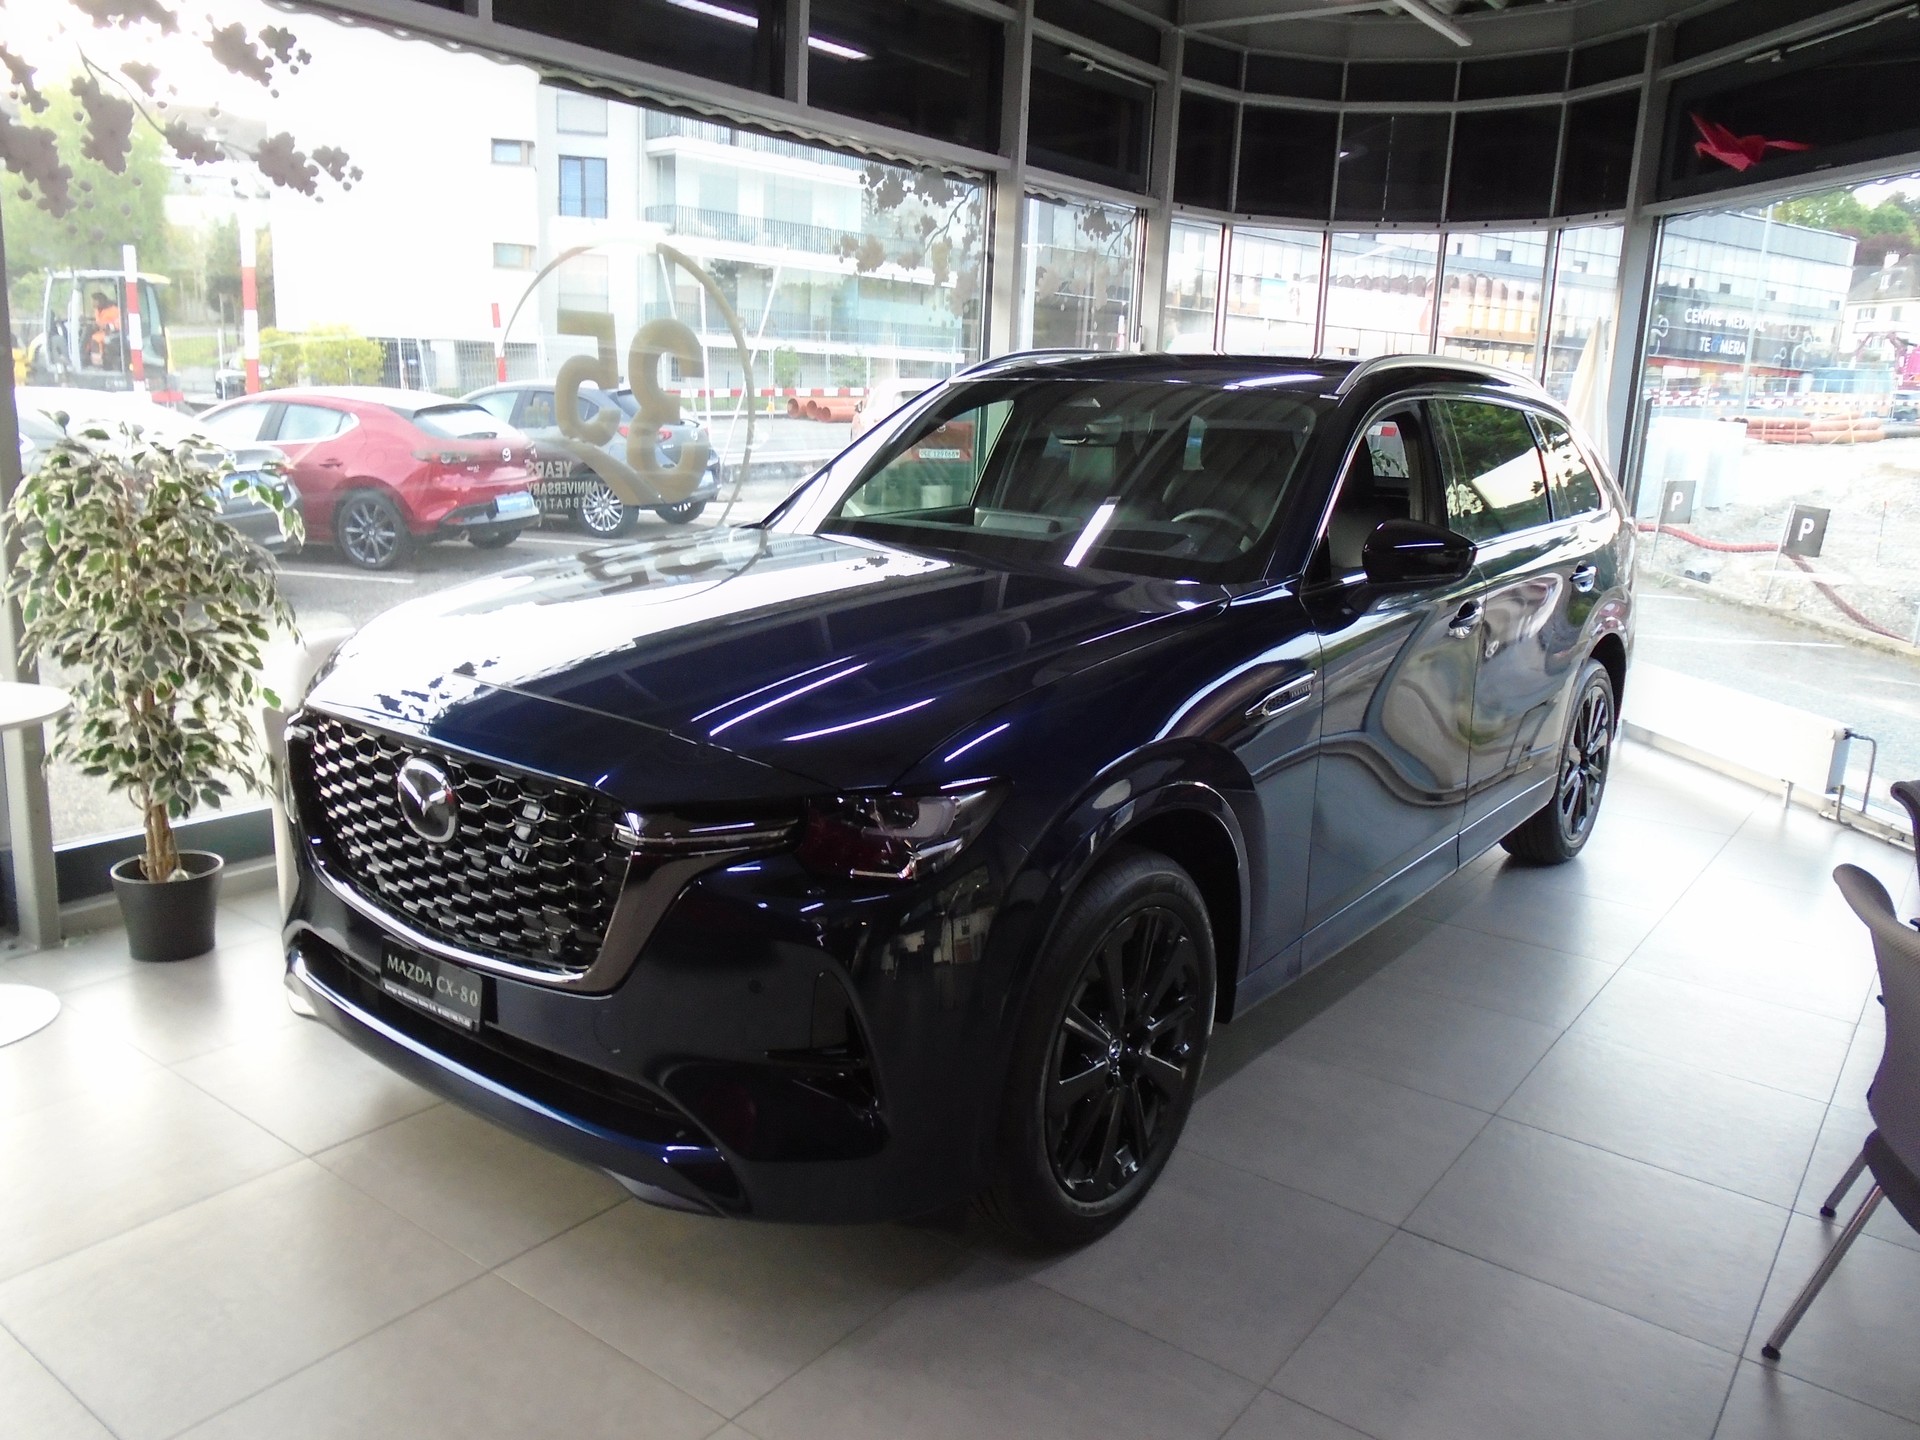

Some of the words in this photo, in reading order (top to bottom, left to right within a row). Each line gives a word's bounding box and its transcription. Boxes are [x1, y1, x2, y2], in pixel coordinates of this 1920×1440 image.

[1684, 308, 1724, 327] CENTRE
[1671, 492, 1684, 511] P
[1797, 517, 1815, 541] P
[387, 955, 432, 987] MAZDA
[436, 976, 478, 1007] CX-80
